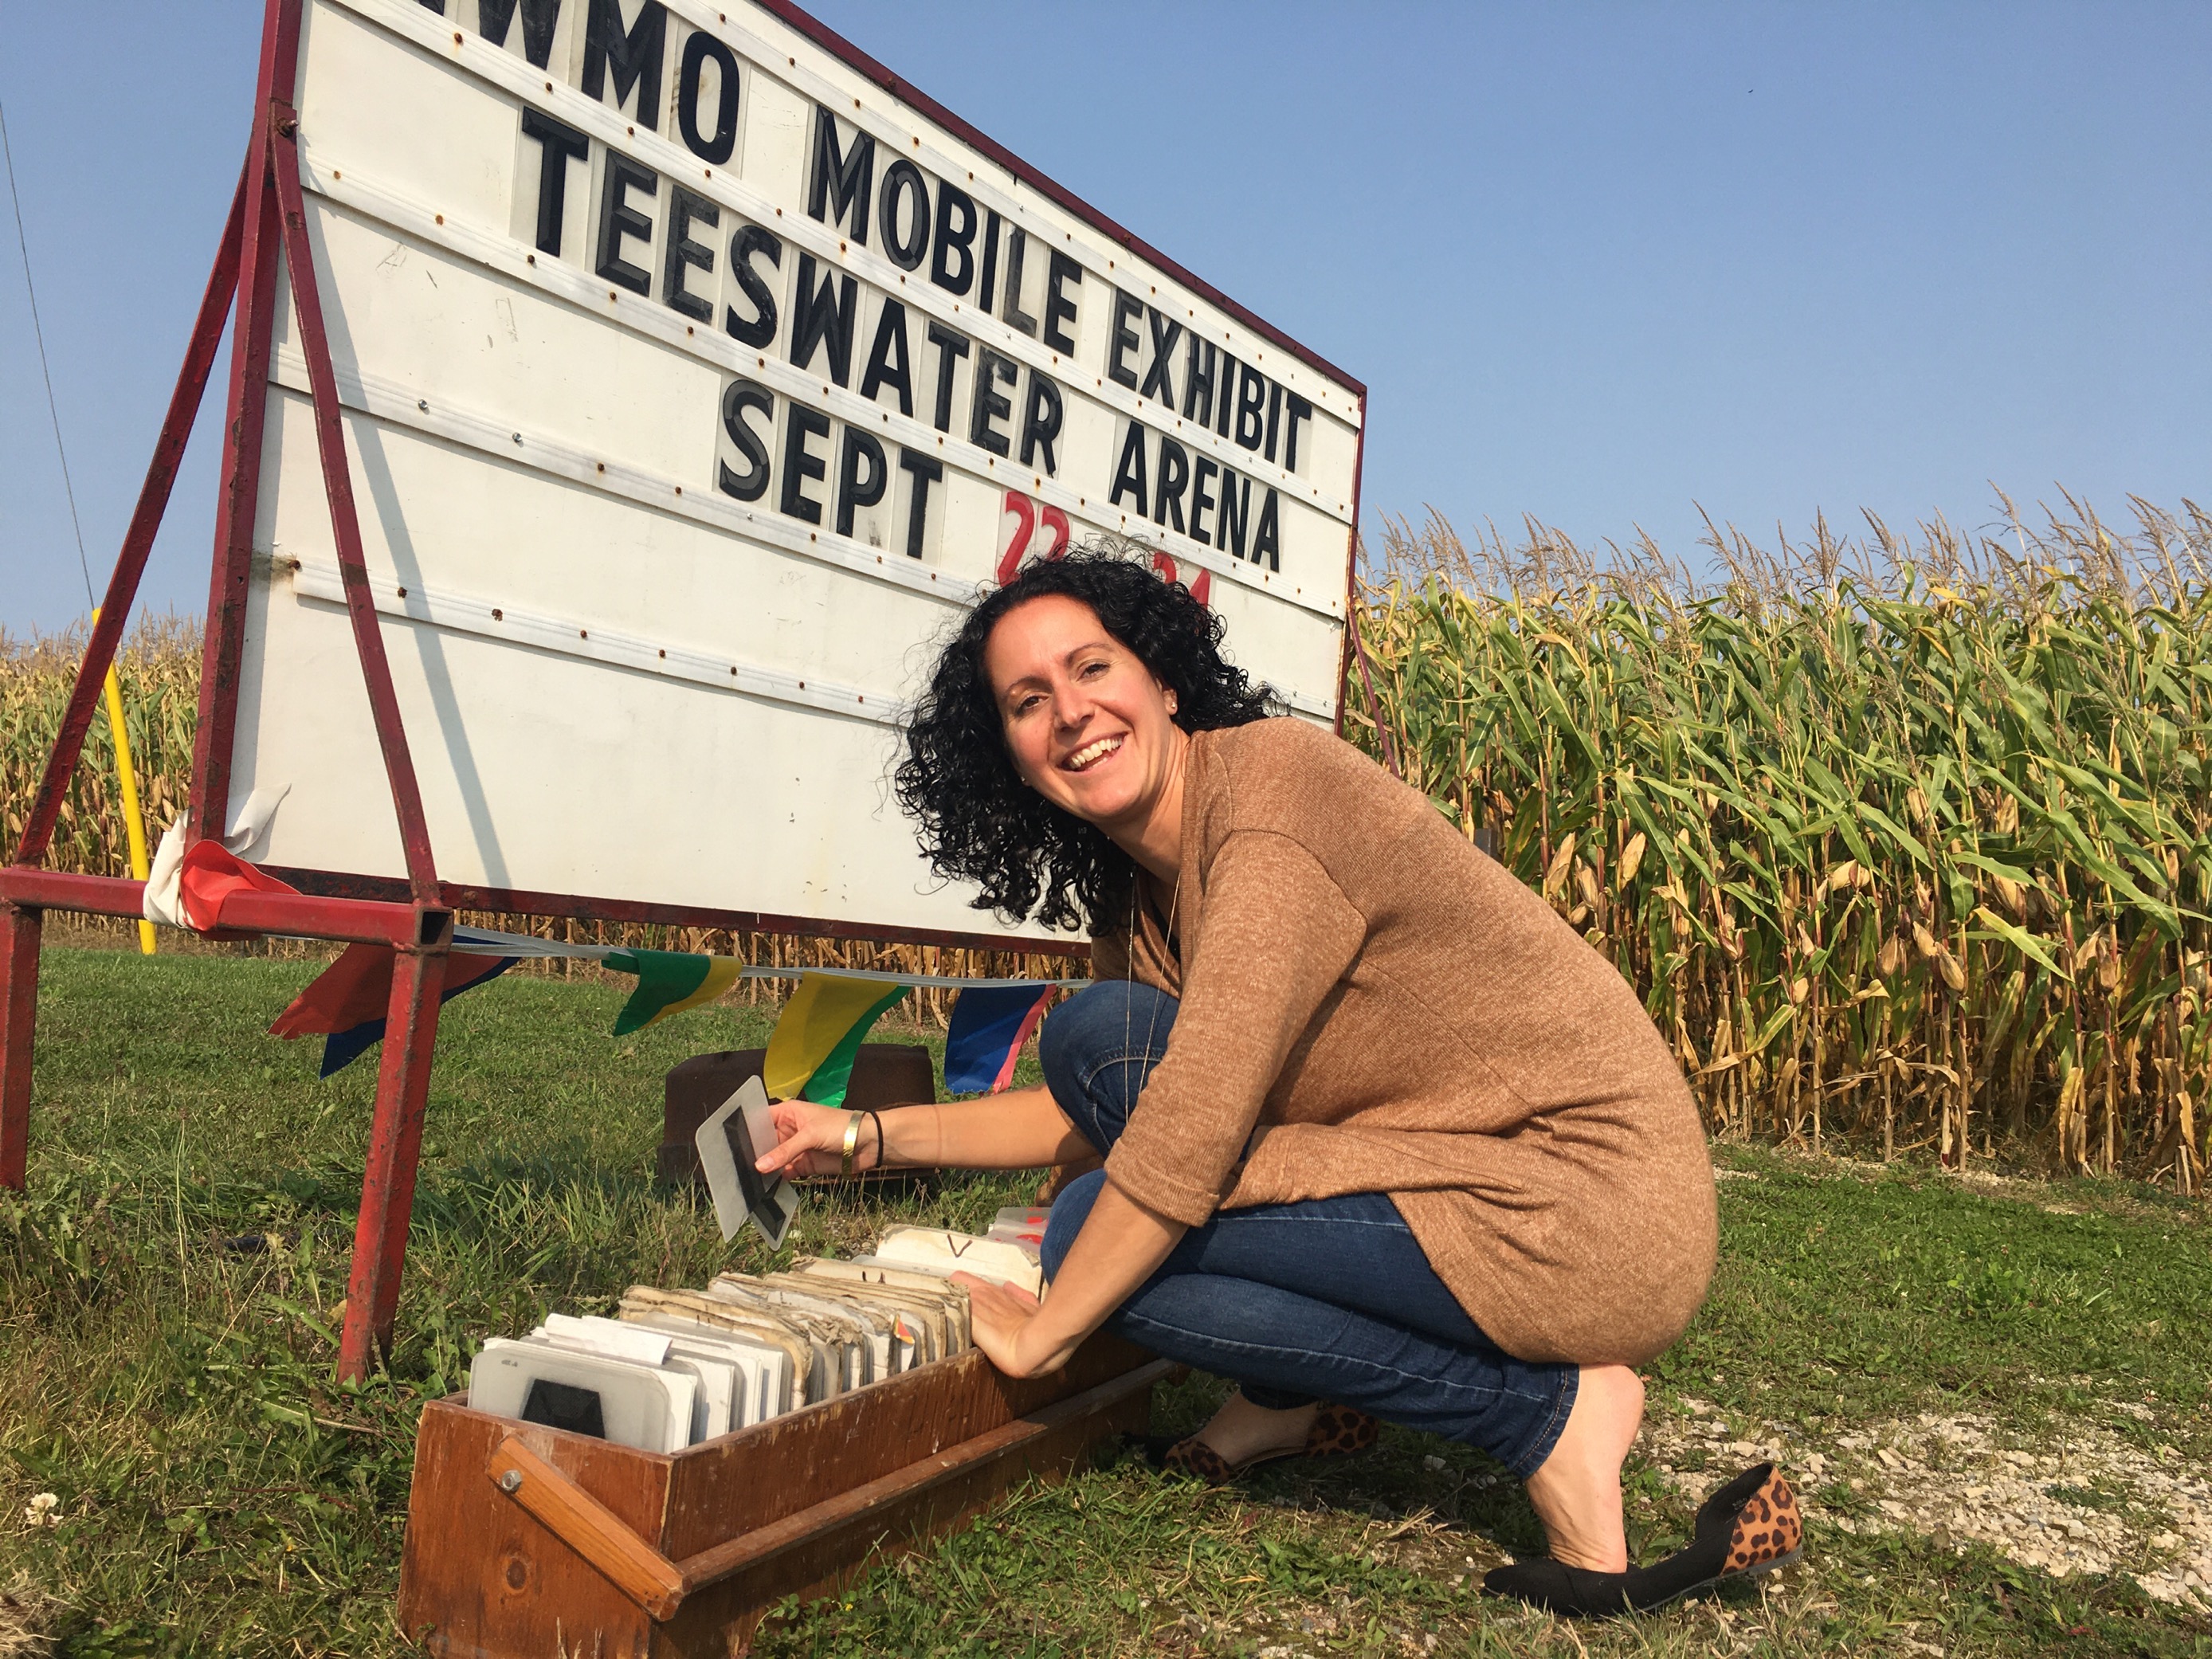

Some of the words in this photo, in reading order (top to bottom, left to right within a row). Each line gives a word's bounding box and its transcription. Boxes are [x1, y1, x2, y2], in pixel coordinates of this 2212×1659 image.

[414, 0, 739, 165] WMO
[808, 104, 1082, 359] MOBILE
[1108, 289, 1312, 473] EXHIBIT
[522, 106, 1064, 478] TEESWATER
[1109, 420, 1280, 573] ARENA
[719, 378, 943, 560] SEPT
